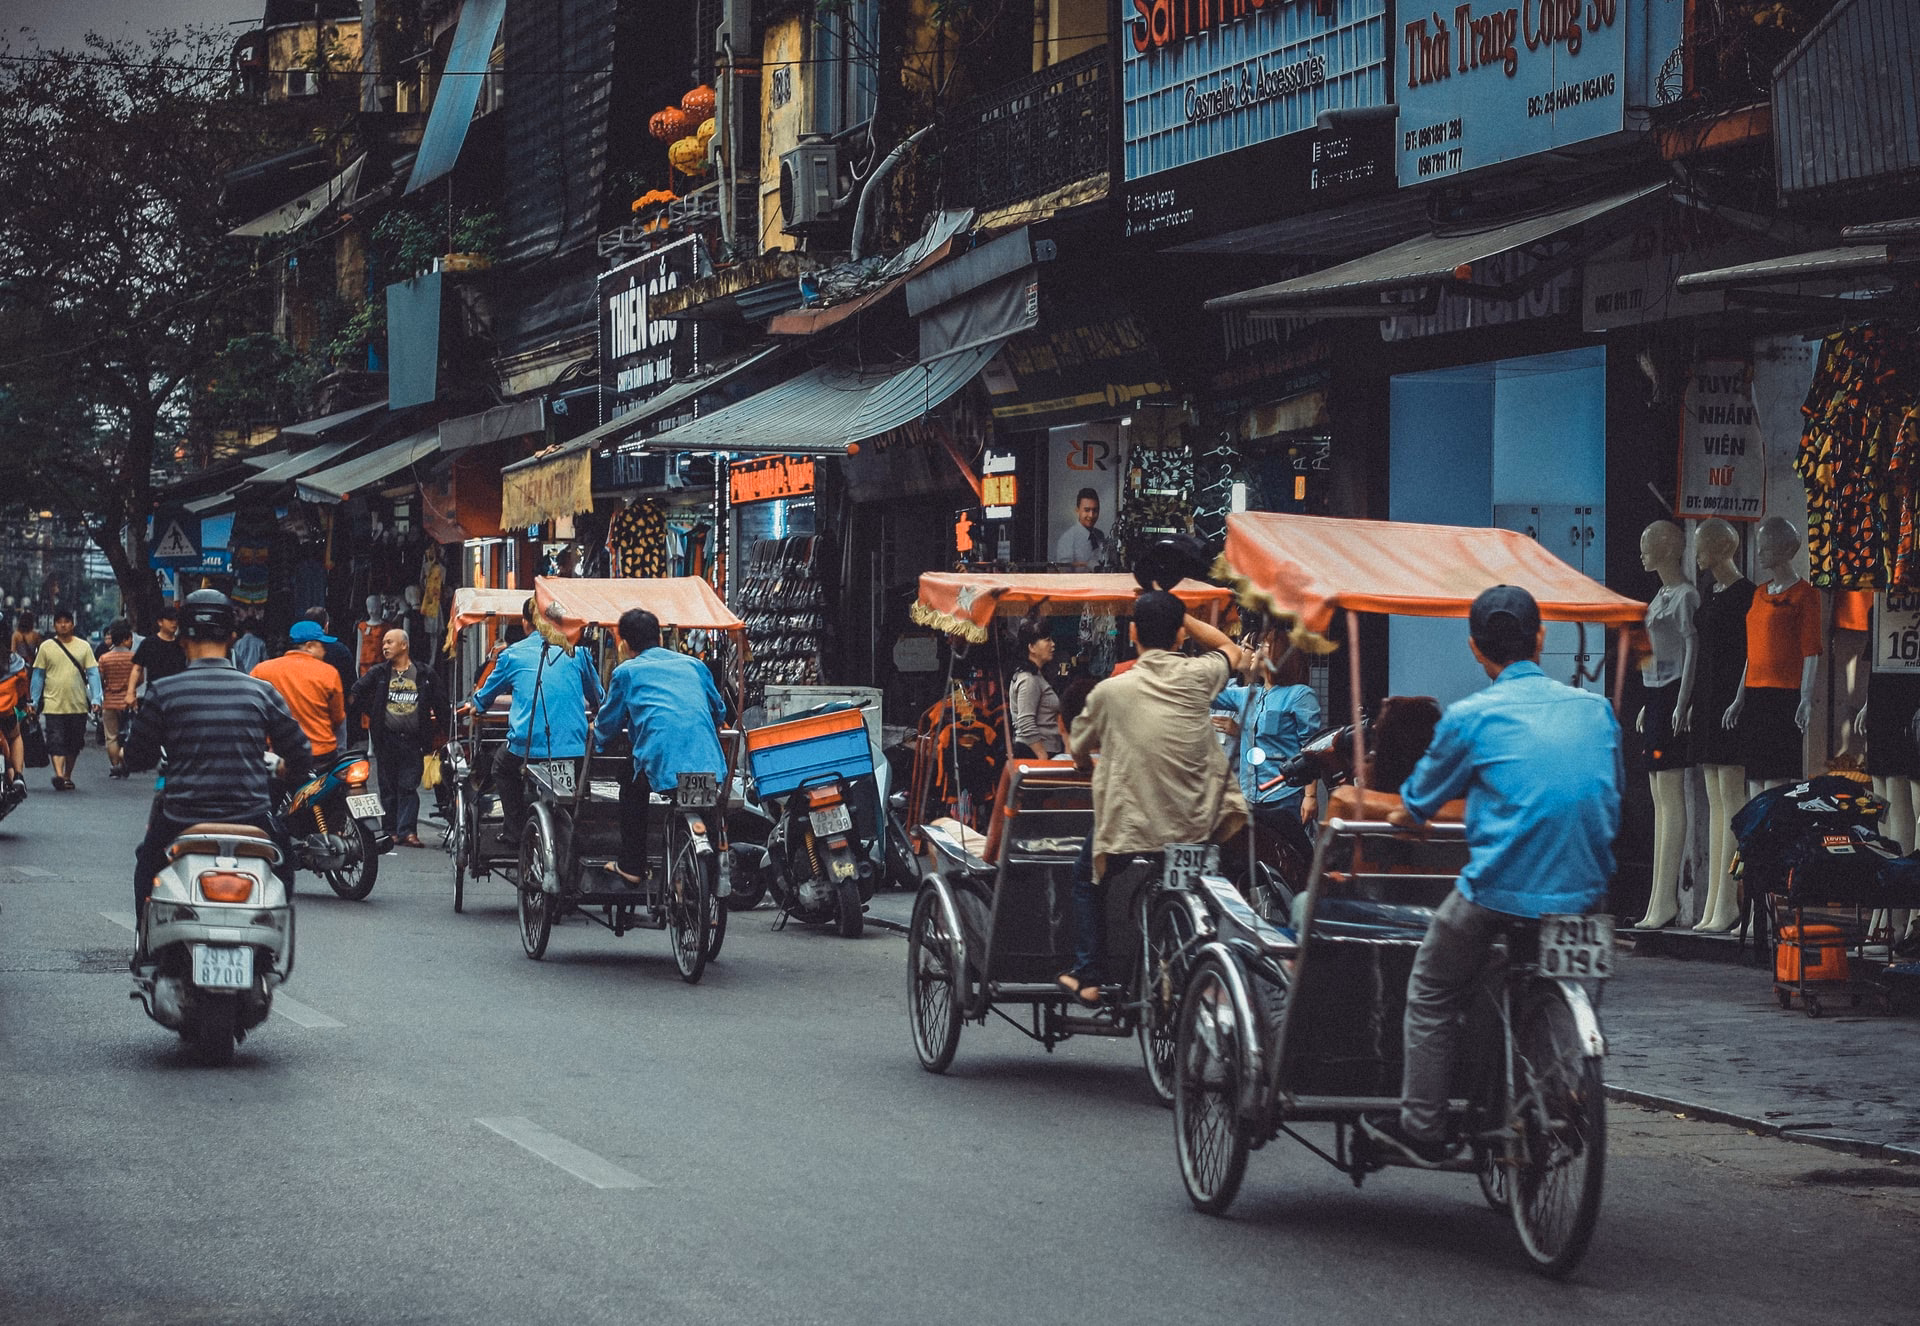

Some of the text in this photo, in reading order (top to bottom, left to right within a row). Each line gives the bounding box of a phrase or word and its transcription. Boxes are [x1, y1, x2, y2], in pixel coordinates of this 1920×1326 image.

[1454, 2, 1519, 78] Trang
[1183, 78, 1237, 122] Cosmetic
[1254, 50, 1327, 102] Accessories
[1556, 81, 1581, 110] HÀNG
[1582, 73, 1615, 103] NGANG
[1448, 147, 1463, 169] 777
[609, 275, 648, 360] THIÊN
[1703, 433, 1746, 456] VIÊN
[684, 775, 710, 790] 29XL
[355, 805, 380, 817] 7136
[202, 967, 243, 985] 8700
